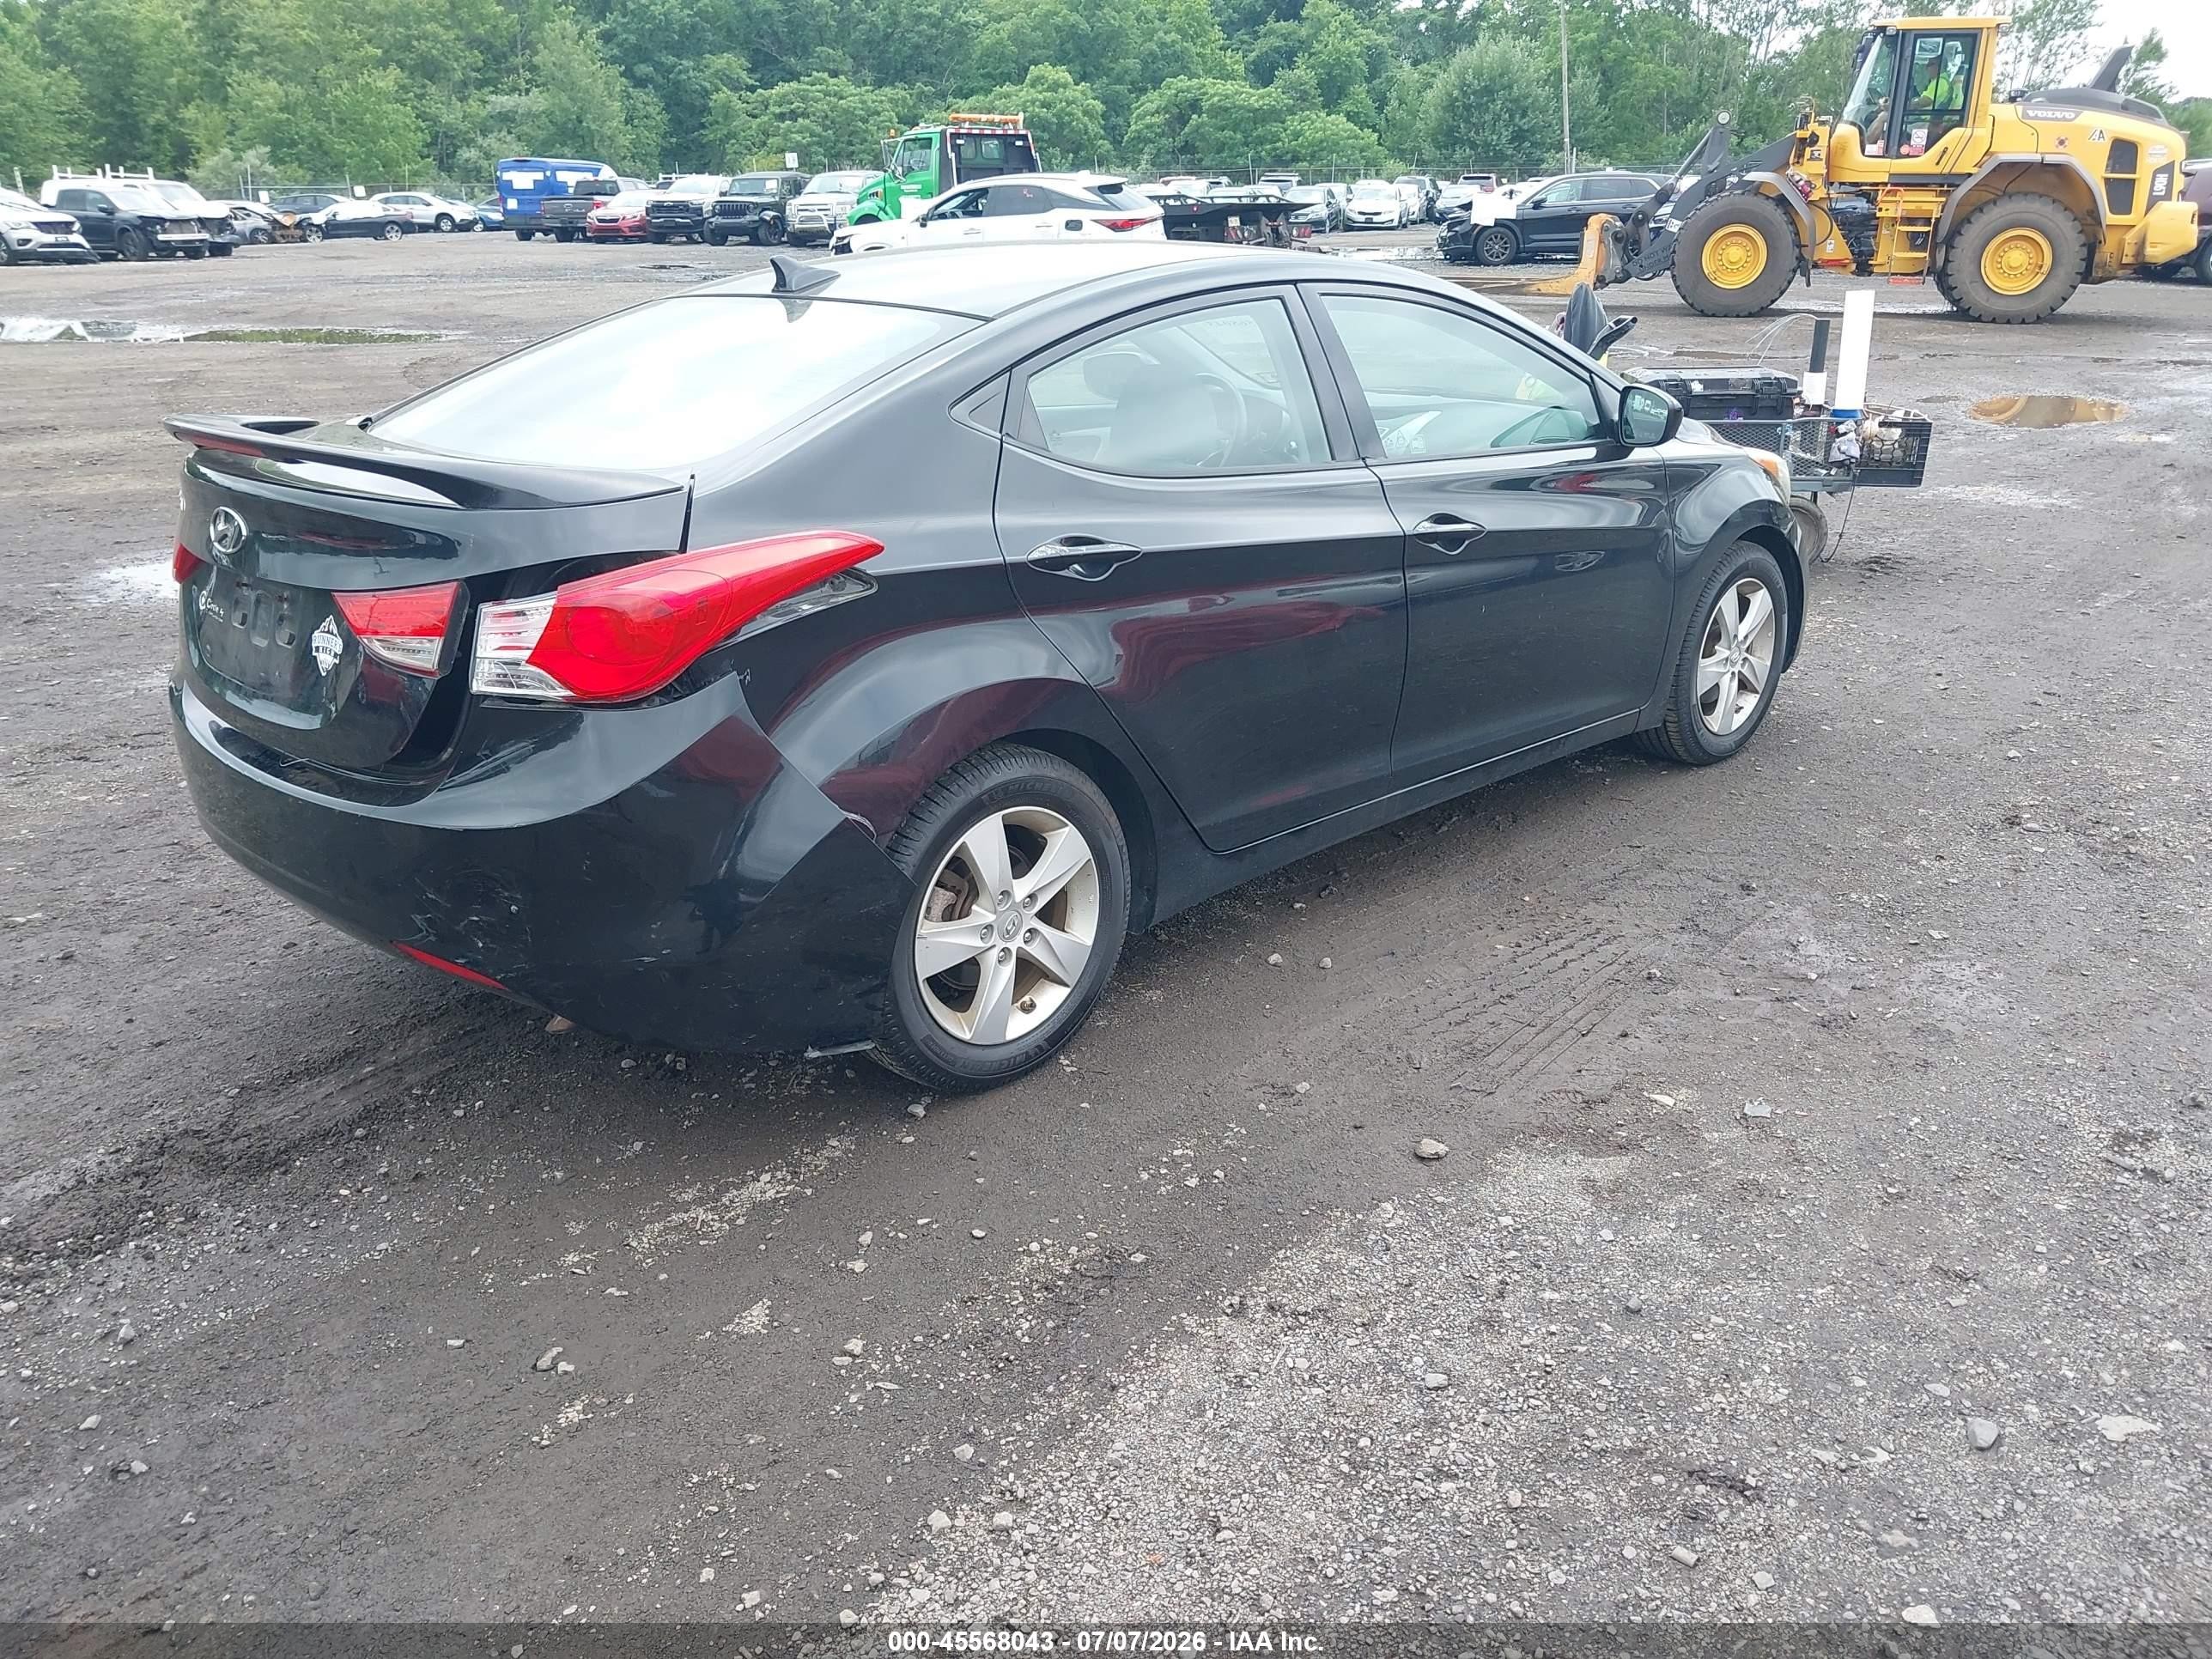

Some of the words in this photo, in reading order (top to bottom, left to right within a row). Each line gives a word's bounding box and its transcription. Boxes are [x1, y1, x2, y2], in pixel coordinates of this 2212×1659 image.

[2026, 109, 2075, 119] VOLVO
[2153, 173, 2169, 196] L90H
[313, 635, 343, 653] RUNNER'S
